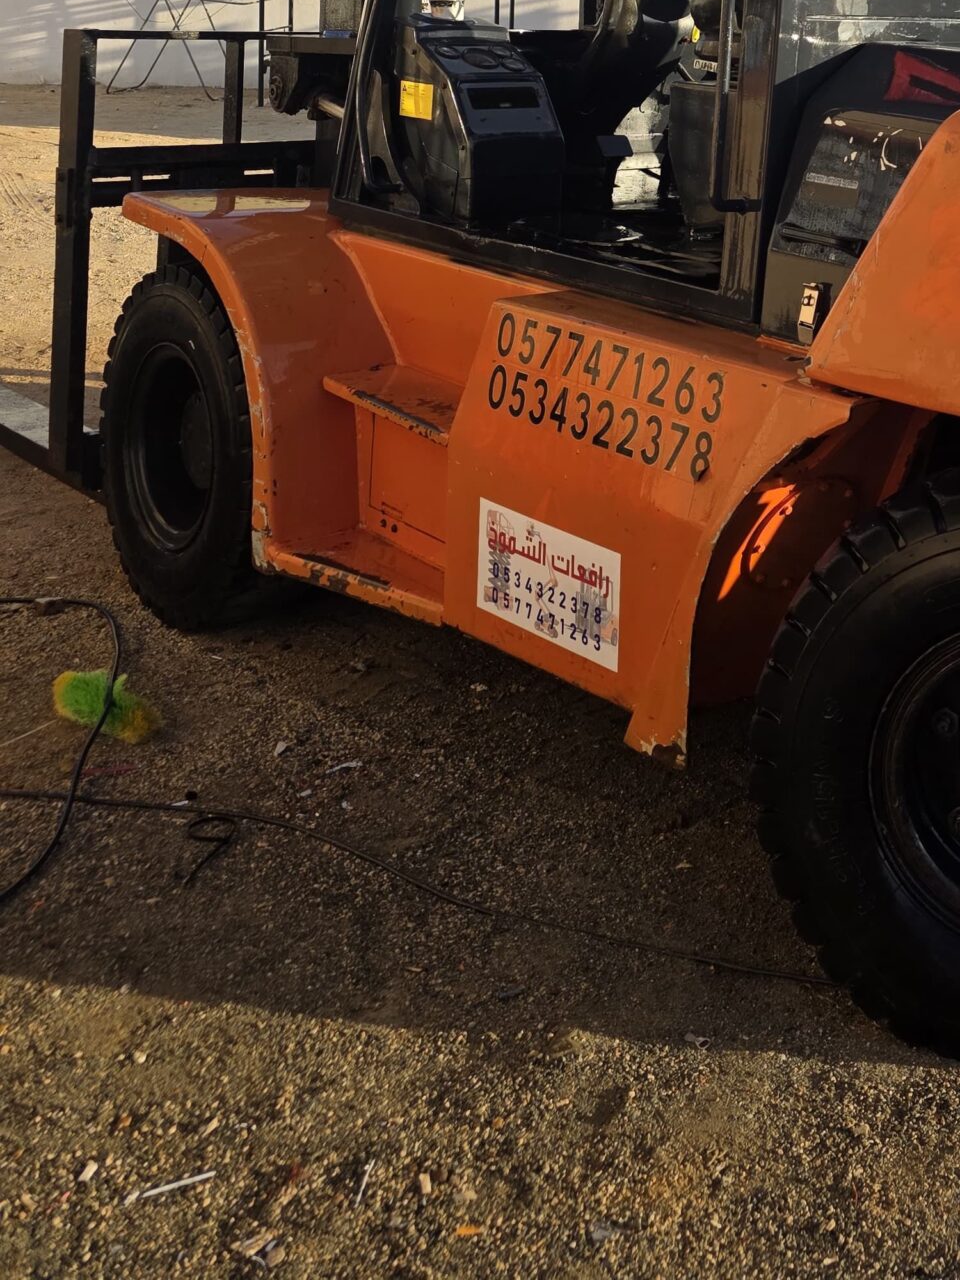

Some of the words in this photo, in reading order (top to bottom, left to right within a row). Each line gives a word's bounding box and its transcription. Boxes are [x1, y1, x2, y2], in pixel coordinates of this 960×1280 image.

[497, 312, 725, 423] 0577471263
[488, 364, 713, 482] 0534322378
[487, 520, 547, 567] الشموخ
[491, 561, 602, 625] 0534322378
[551, 554, 610, 599] رافعات
[491, 587, 601, 652] 0577471263
